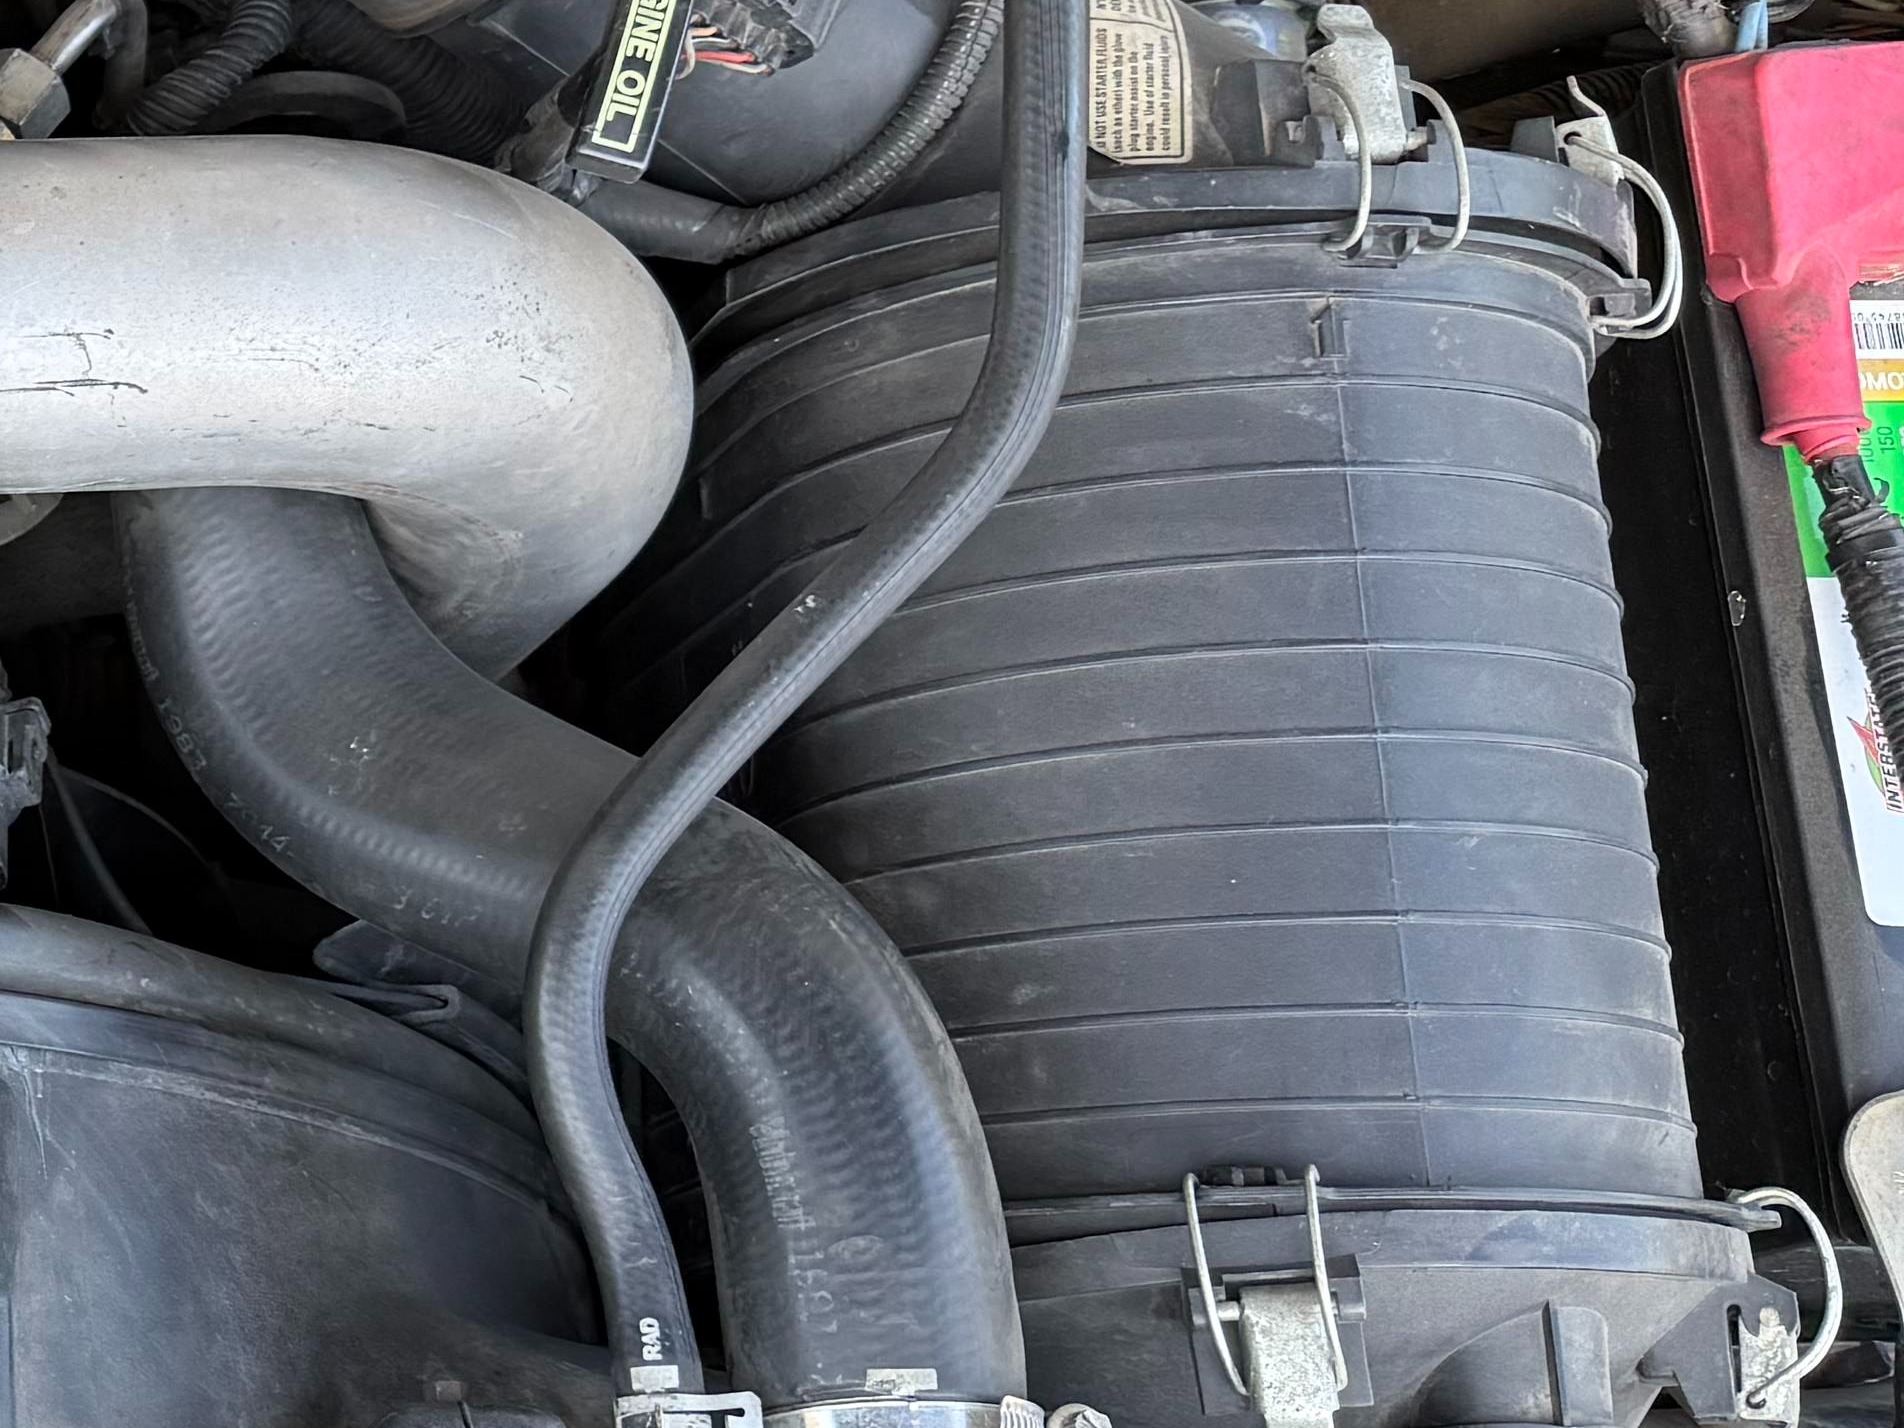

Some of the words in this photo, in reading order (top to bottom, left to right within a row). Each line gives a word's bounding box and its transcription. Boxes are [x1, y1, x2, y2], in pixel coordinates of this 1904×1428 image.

[1095, 28, 1107, 57] FLUIDS
[1112, 55, 1124, 68] the
[1095, 58, 1107, 98] STARTER
[1112, 70, 1124, 88] with
[606, 69, 646, 122] OIL
[1876, 426, 1895, 454] 150
[639, 1317, 662, 1360] RAD
